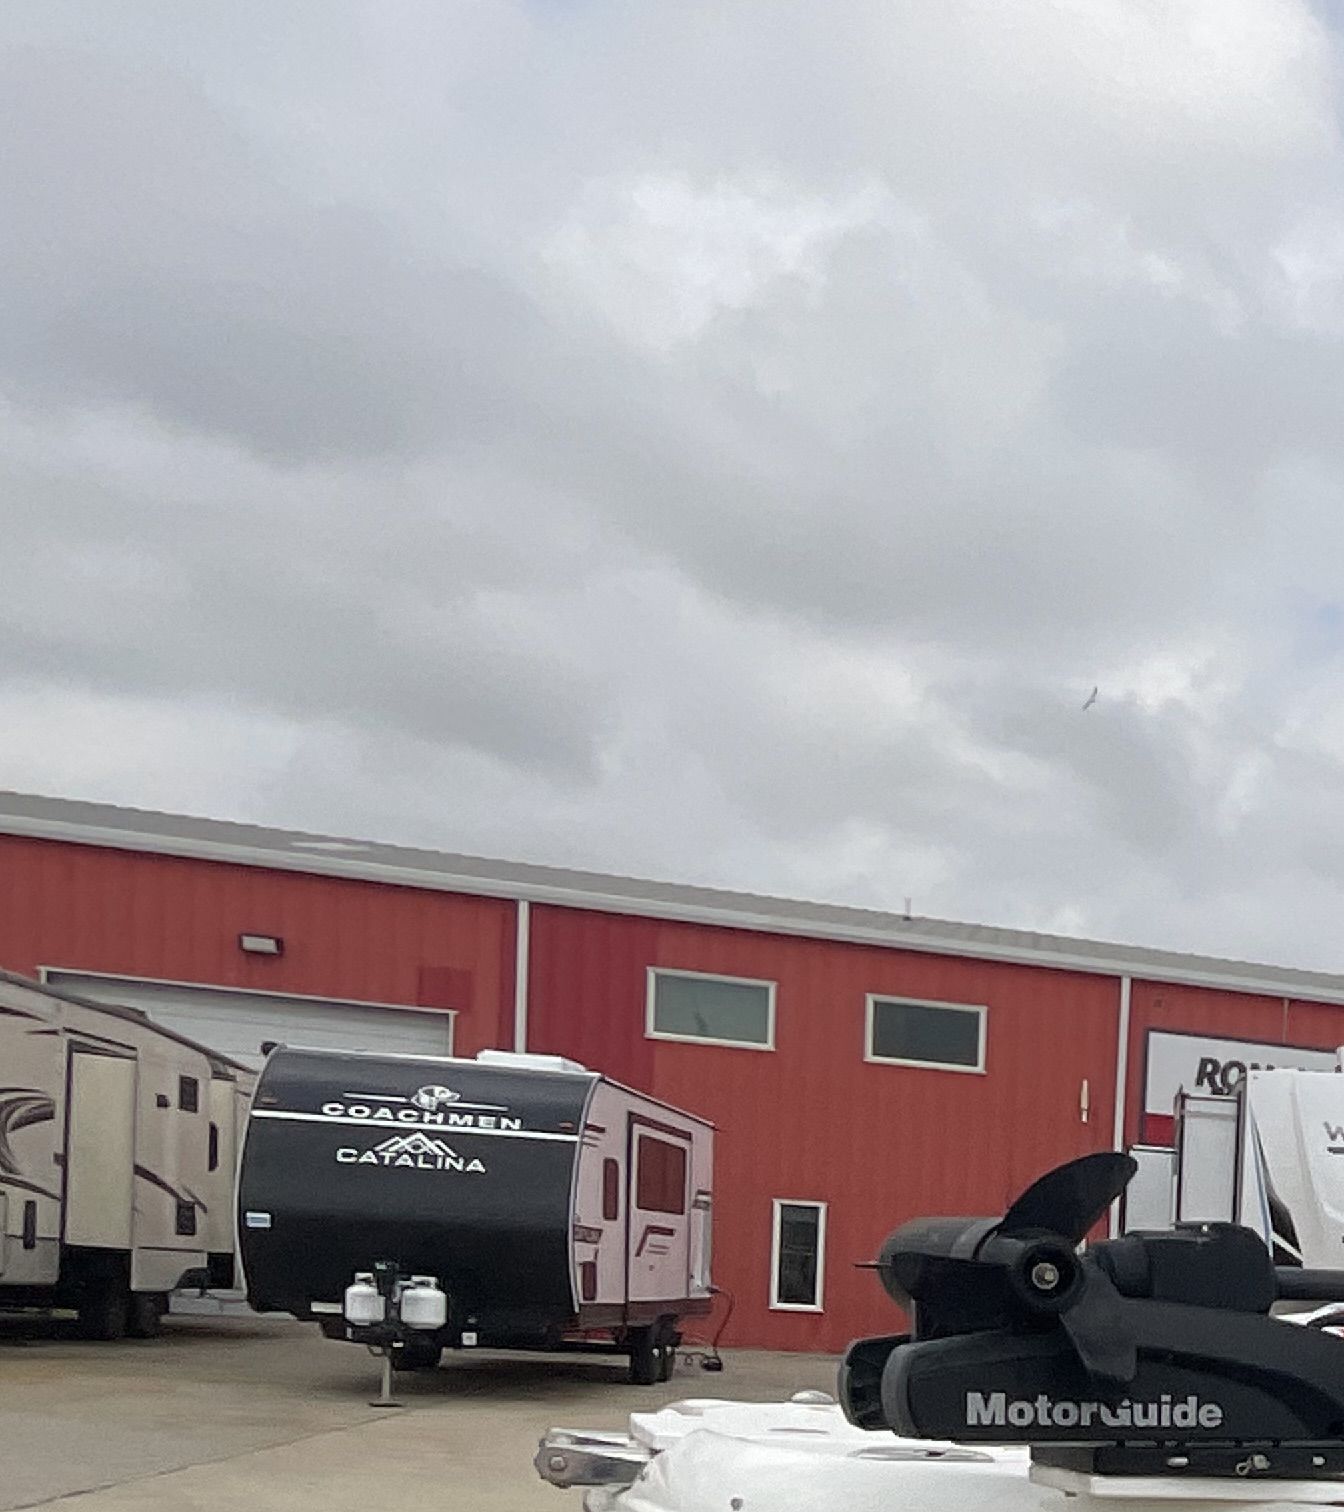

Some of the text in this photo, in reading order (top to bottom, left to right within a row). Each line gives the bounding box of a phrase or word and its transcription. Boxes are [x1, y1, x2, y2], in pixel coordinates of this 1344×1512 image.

[321, 1102, 523, 1130] COACHMEN
[336, 1148, 486, 1173] CATALINA
[966, 1392, 1223, 1428] MotorGuide
